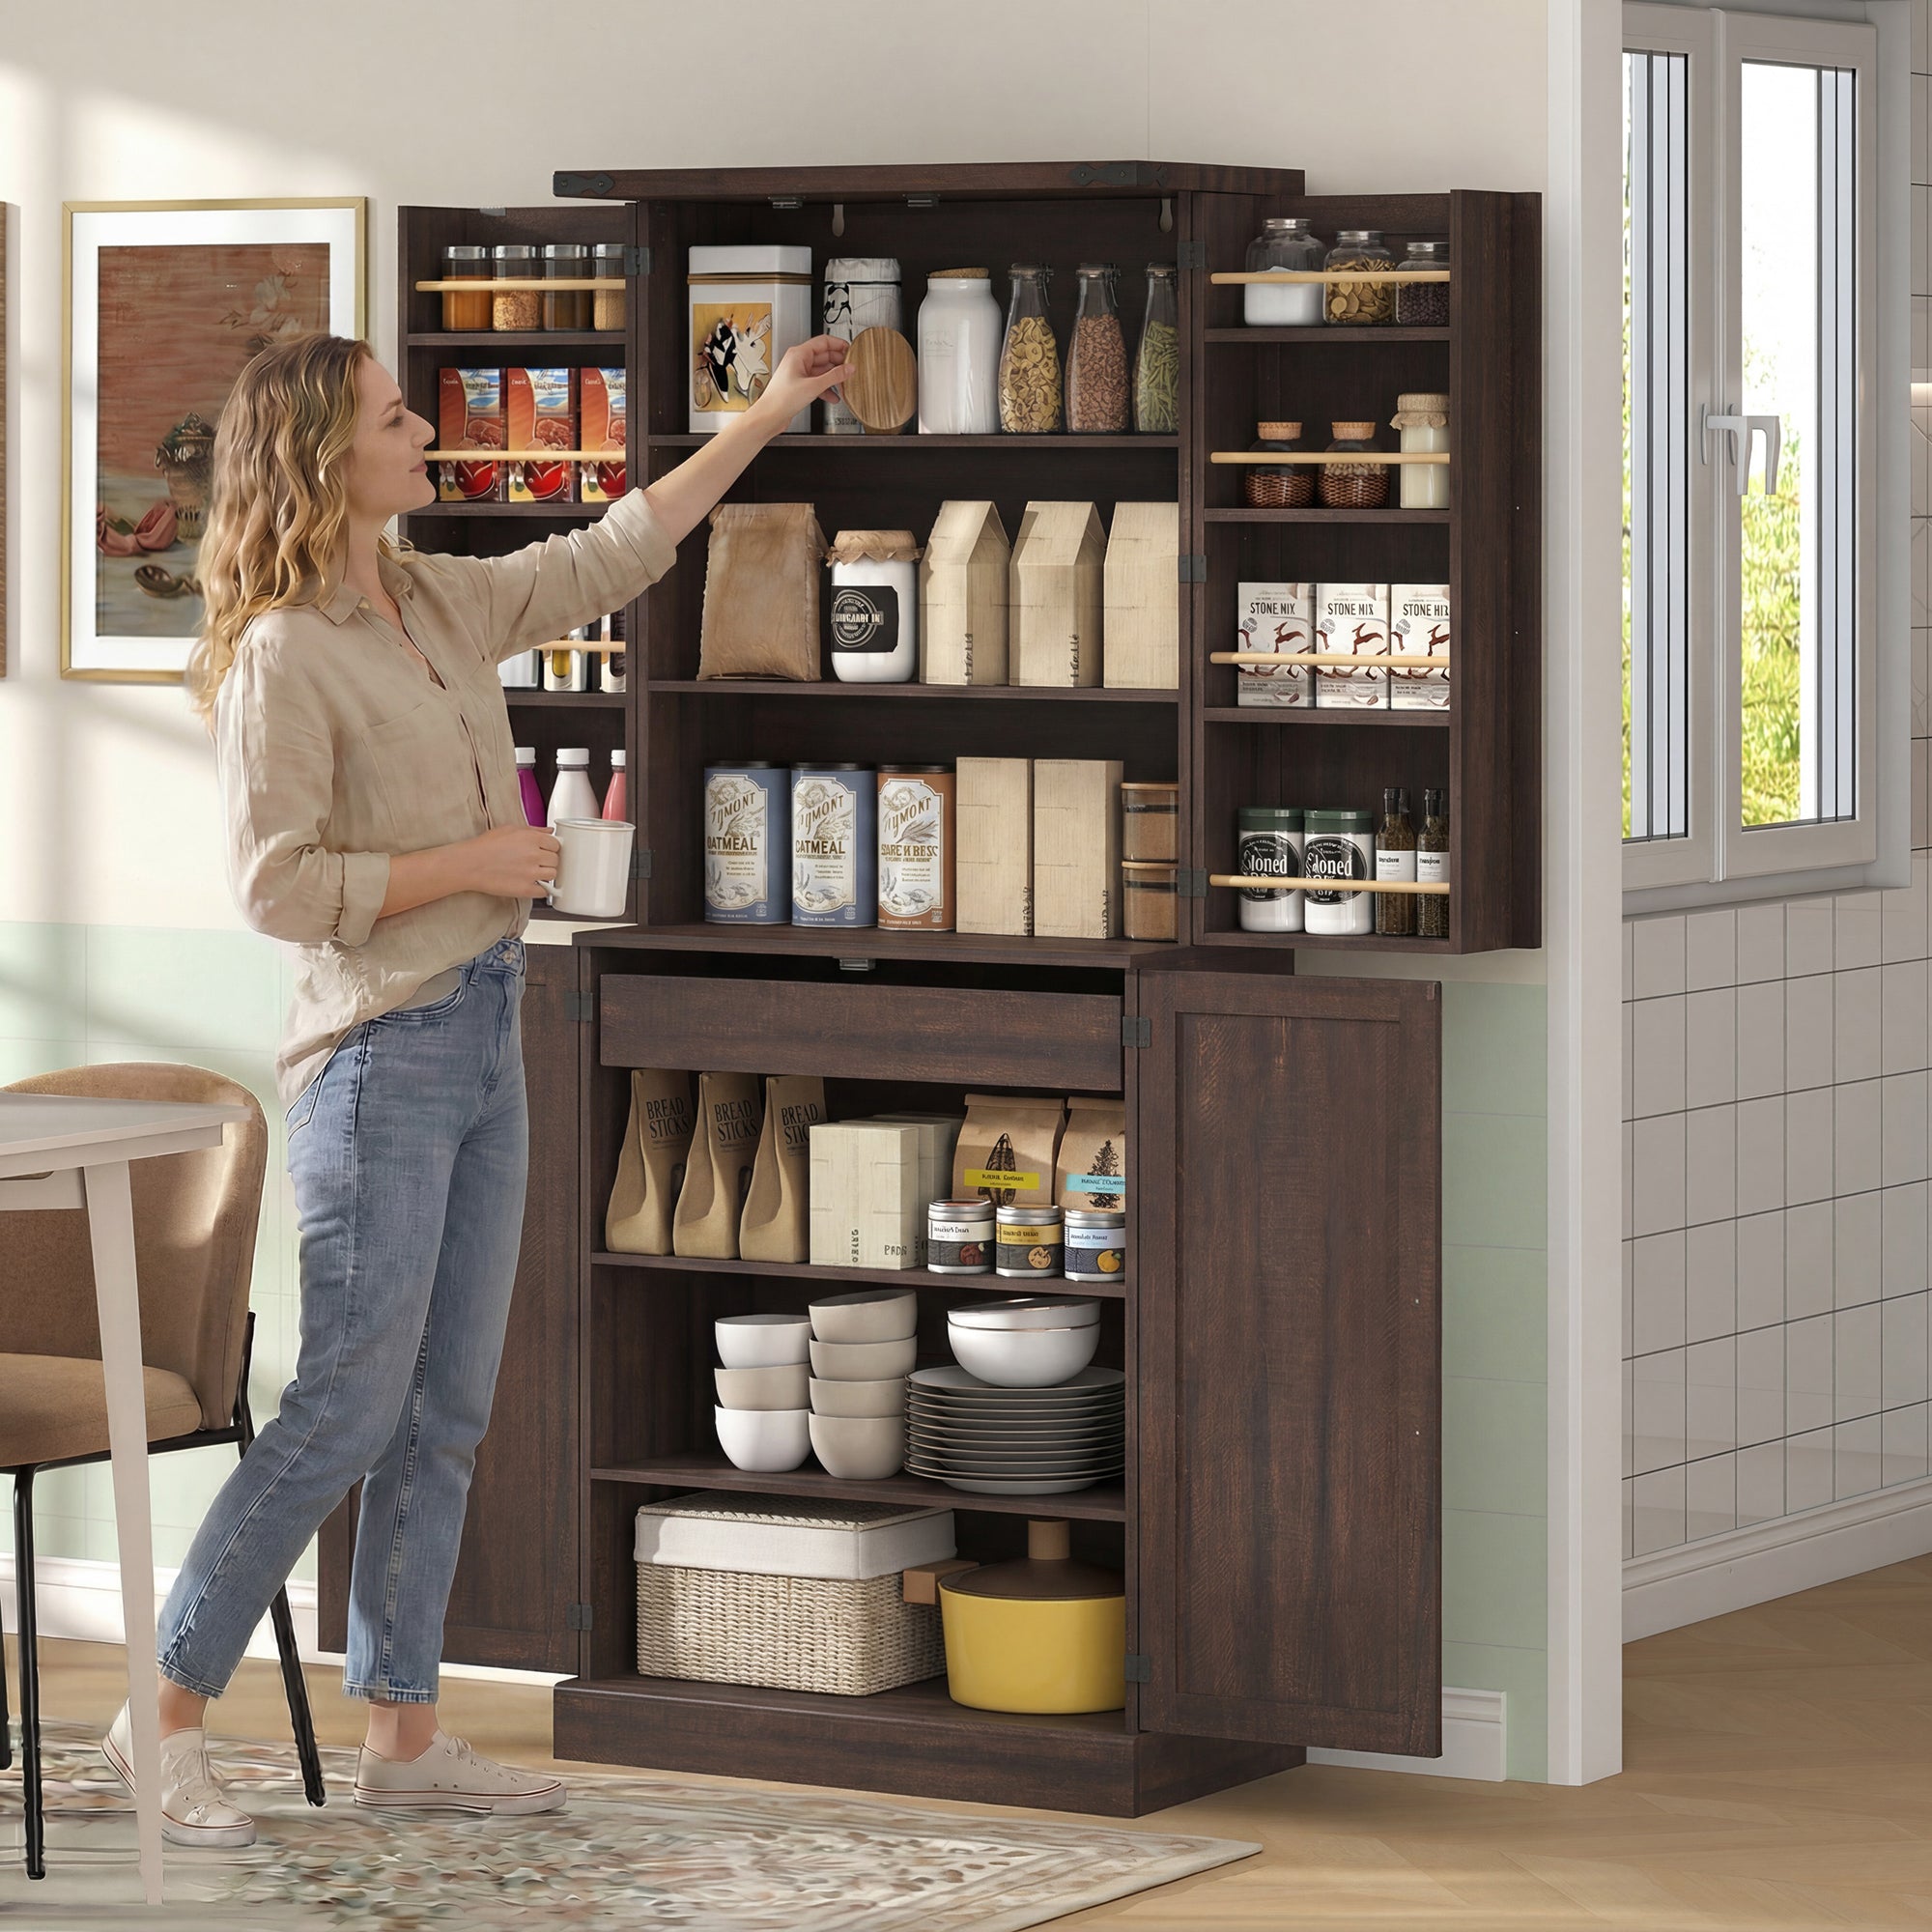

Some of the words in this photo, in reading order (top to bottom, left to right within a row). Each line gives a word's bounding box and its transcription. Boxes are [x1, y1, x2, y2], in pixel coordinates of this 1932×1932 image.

[1250, 602, 1279, 614] STONE
[1327, 603, 1356, 615] STONE
[1403, 603, 1432, 616] STONE
[706, 836, 757, 851] OATMEAL
[645, 1096, 685, 1121] BREAD
[713, 1099, 753, 1123] BREAD
[781, 1103, 819, 1126] BREAD
[648, 1114, 690, 1139] STICKS
[717, 1118, 758, 1143] STICKS
